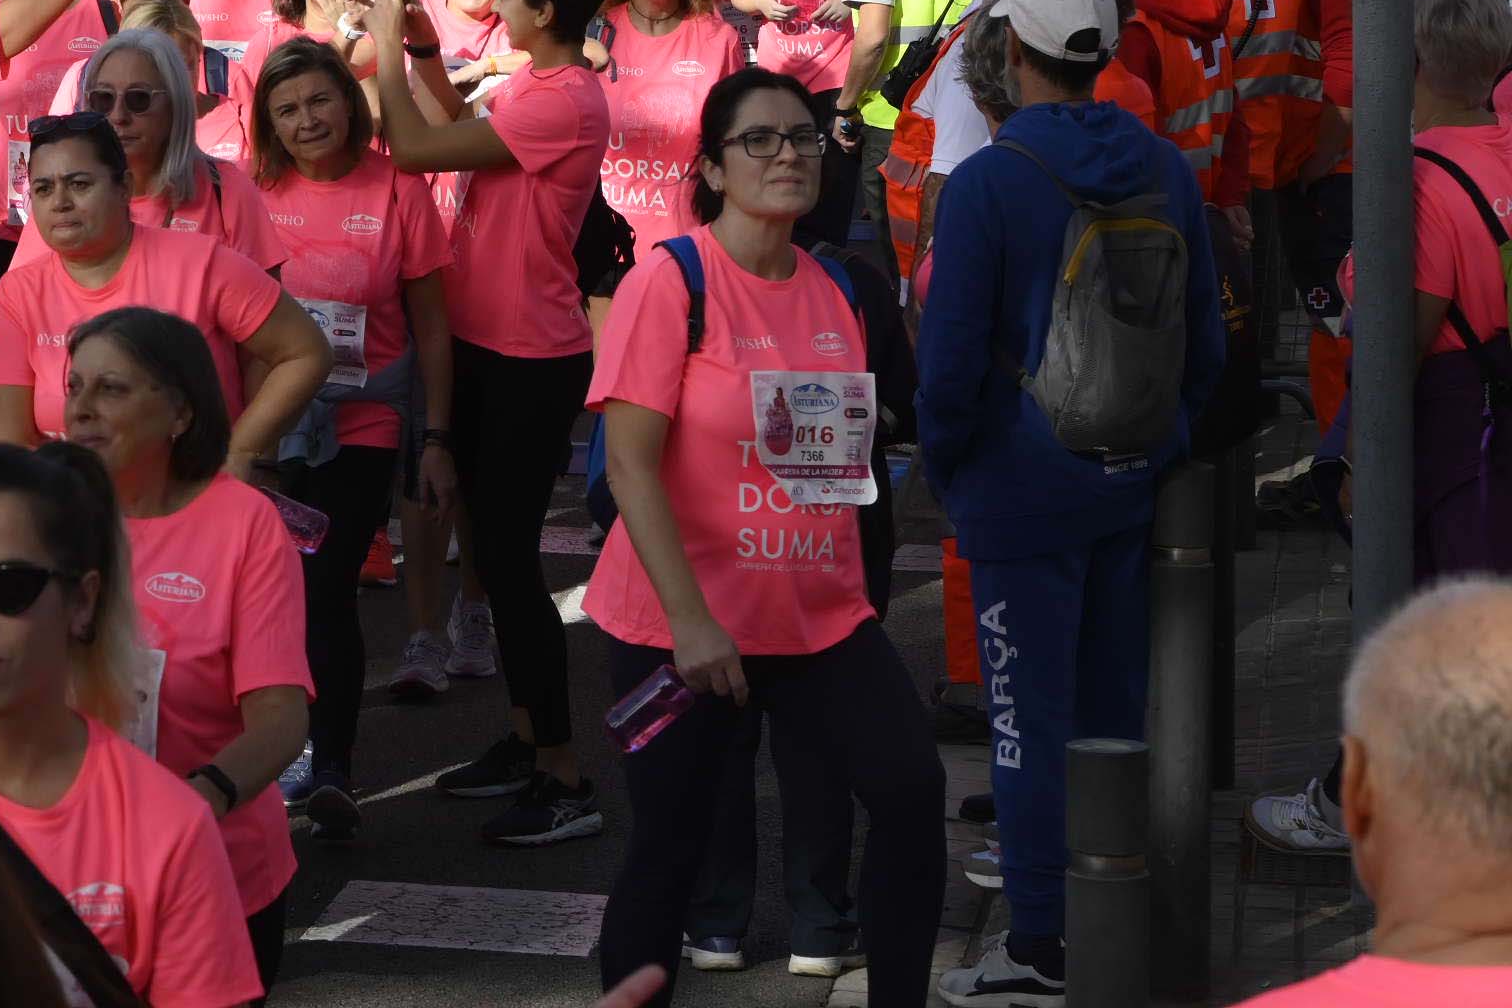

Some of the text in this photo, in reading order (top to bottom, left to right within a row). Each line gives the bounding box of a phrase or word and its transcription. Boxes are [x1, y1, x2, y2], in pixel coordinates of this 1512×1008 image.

[777, 39, 823, 55] SUMA
[602, 183, 667, 210] SUMA
[842, 390, 866, 399] SUMA
[792, 396, 838, 410] ASTURIANA
[794, 425, 835, 445] 016
[800, 450, 825, 462] 7366
[819, 467, 845, 477] MUJER
[1104, 463, 1129, 475] SINCE
[736, 527, 835, 561] SUMA
[148, 581, 202, 599] ASTURIANA
[979, 599, 1021, 770] BARÇA
